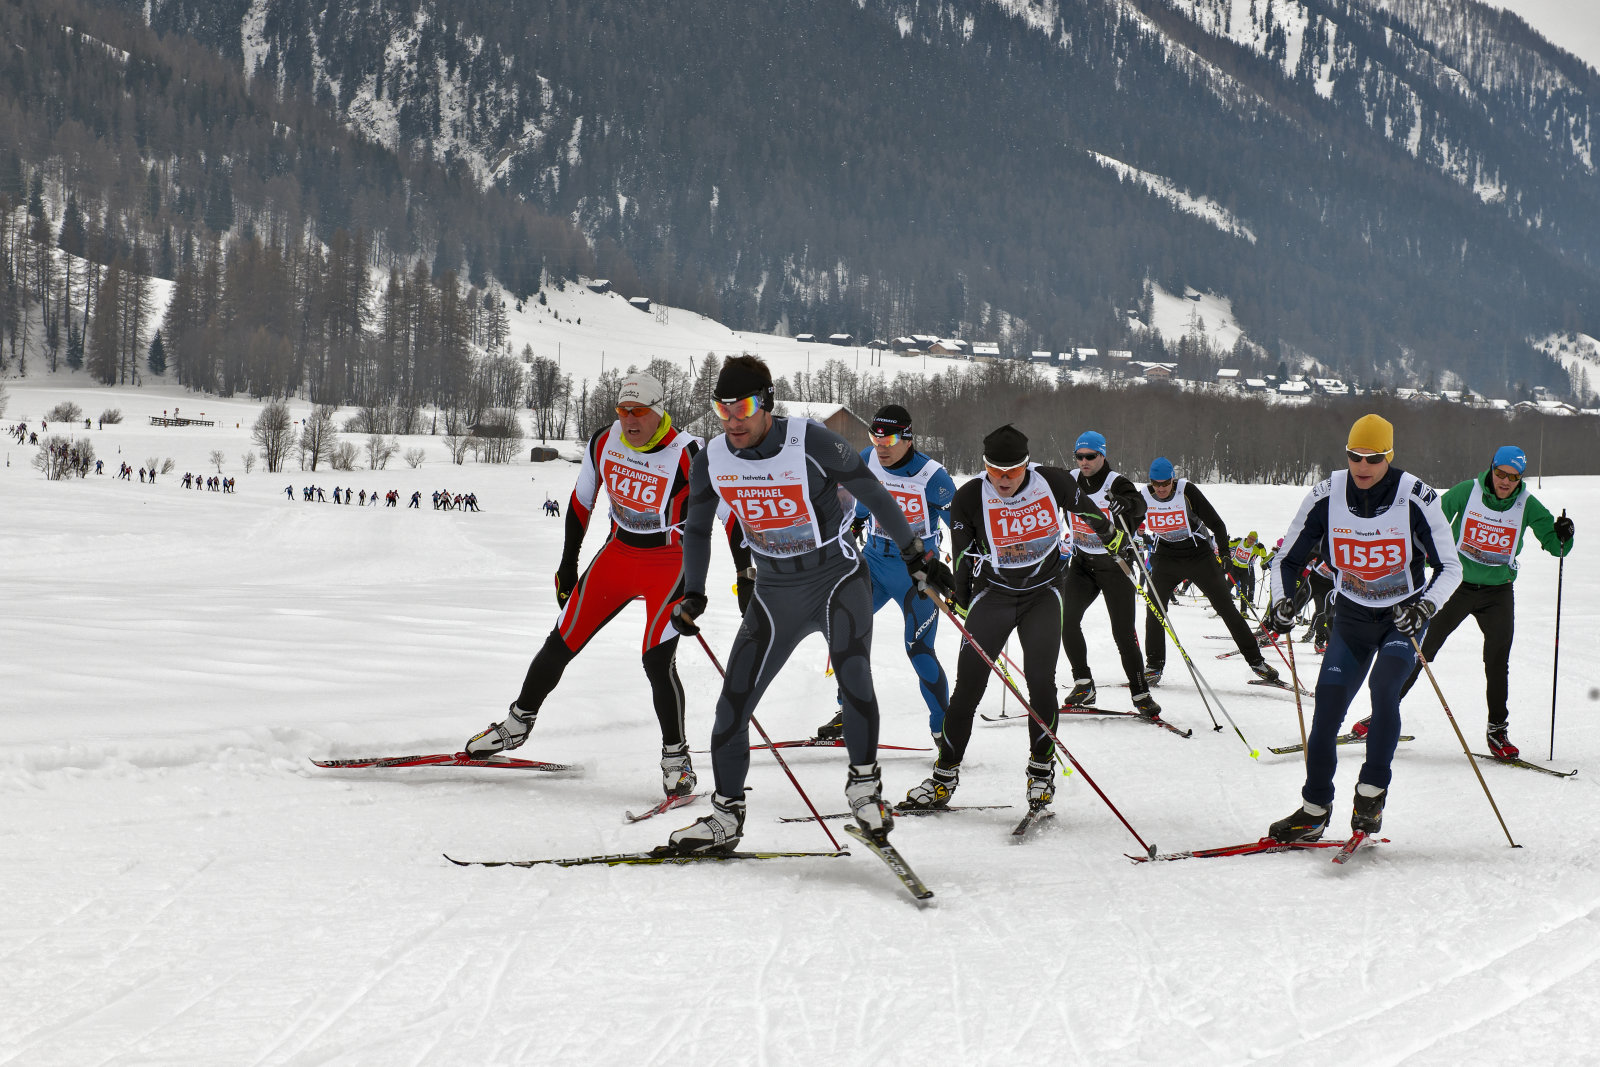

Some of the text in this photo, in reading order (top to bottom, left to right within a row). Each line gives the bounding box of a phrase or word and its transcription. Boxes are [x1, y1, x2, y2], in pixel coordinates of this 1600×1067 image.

[608, 450, 624, 459] coop
[612, 464, 658, 485] ALEXANDER
[716, 474, 739, 482] coop
[609, 474, 657, 504] 1416
[736, 489, 784, 498] RAPHAEL
[731, 498, 798, 519] 1519
[896, 496, 921, 513] 56
[997, 509, 1053, 537] 1498
[1150, 513, 1184, 527] 1565
[1477, 522, 1505, 534] DOMINIK
[1469, 527, 1511, 547] 1506
[1338, 544, 1402, 568] 1553
[915, 608, 938, 639] ATOMIC
[1266, 846, 1292, 854] ATOMIC
